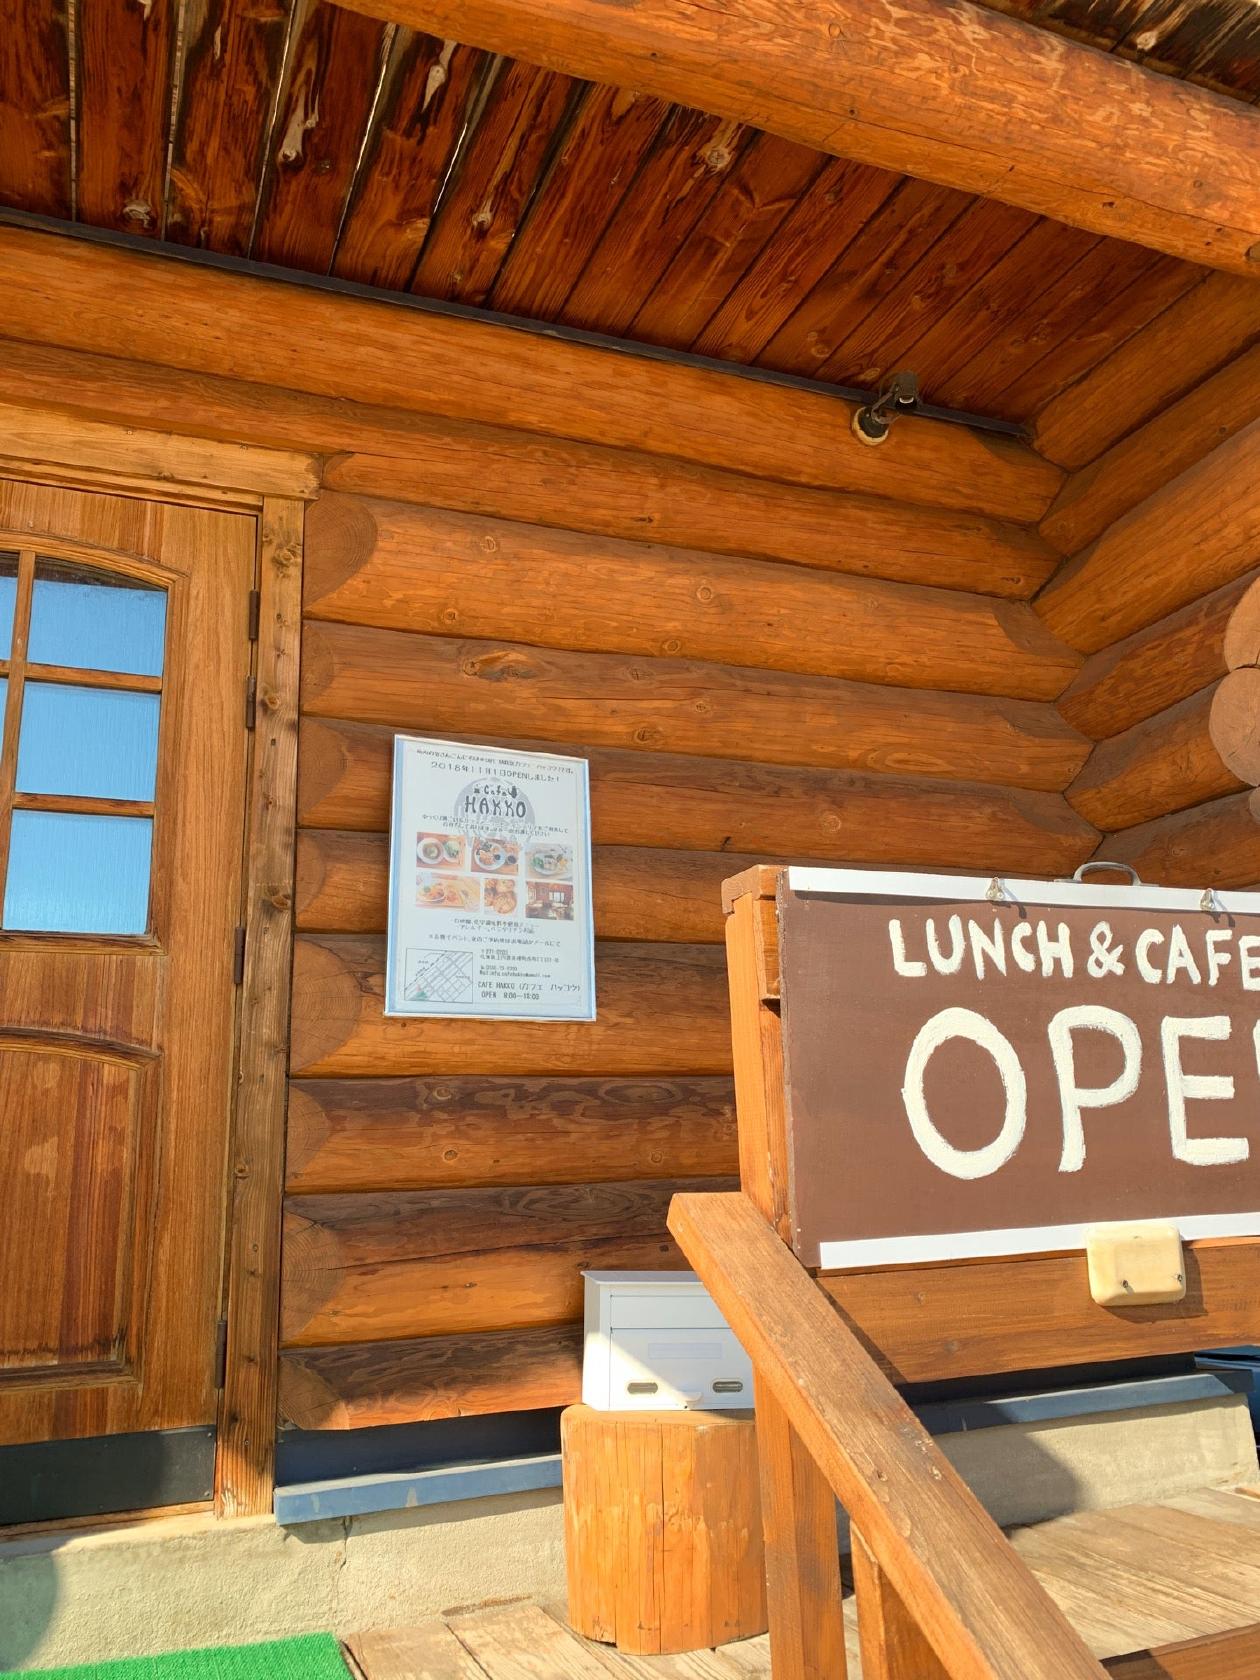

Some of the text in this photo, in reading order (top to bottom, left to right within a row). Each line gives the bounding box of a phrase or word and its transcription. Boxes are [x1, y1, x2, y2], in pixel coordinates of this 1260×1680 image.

[465, 795, 526, 818] HAKKO
[889, 913, 1260, 991] LUNCH & CAFE
[901, 1005, 1260, 1180] OPE
